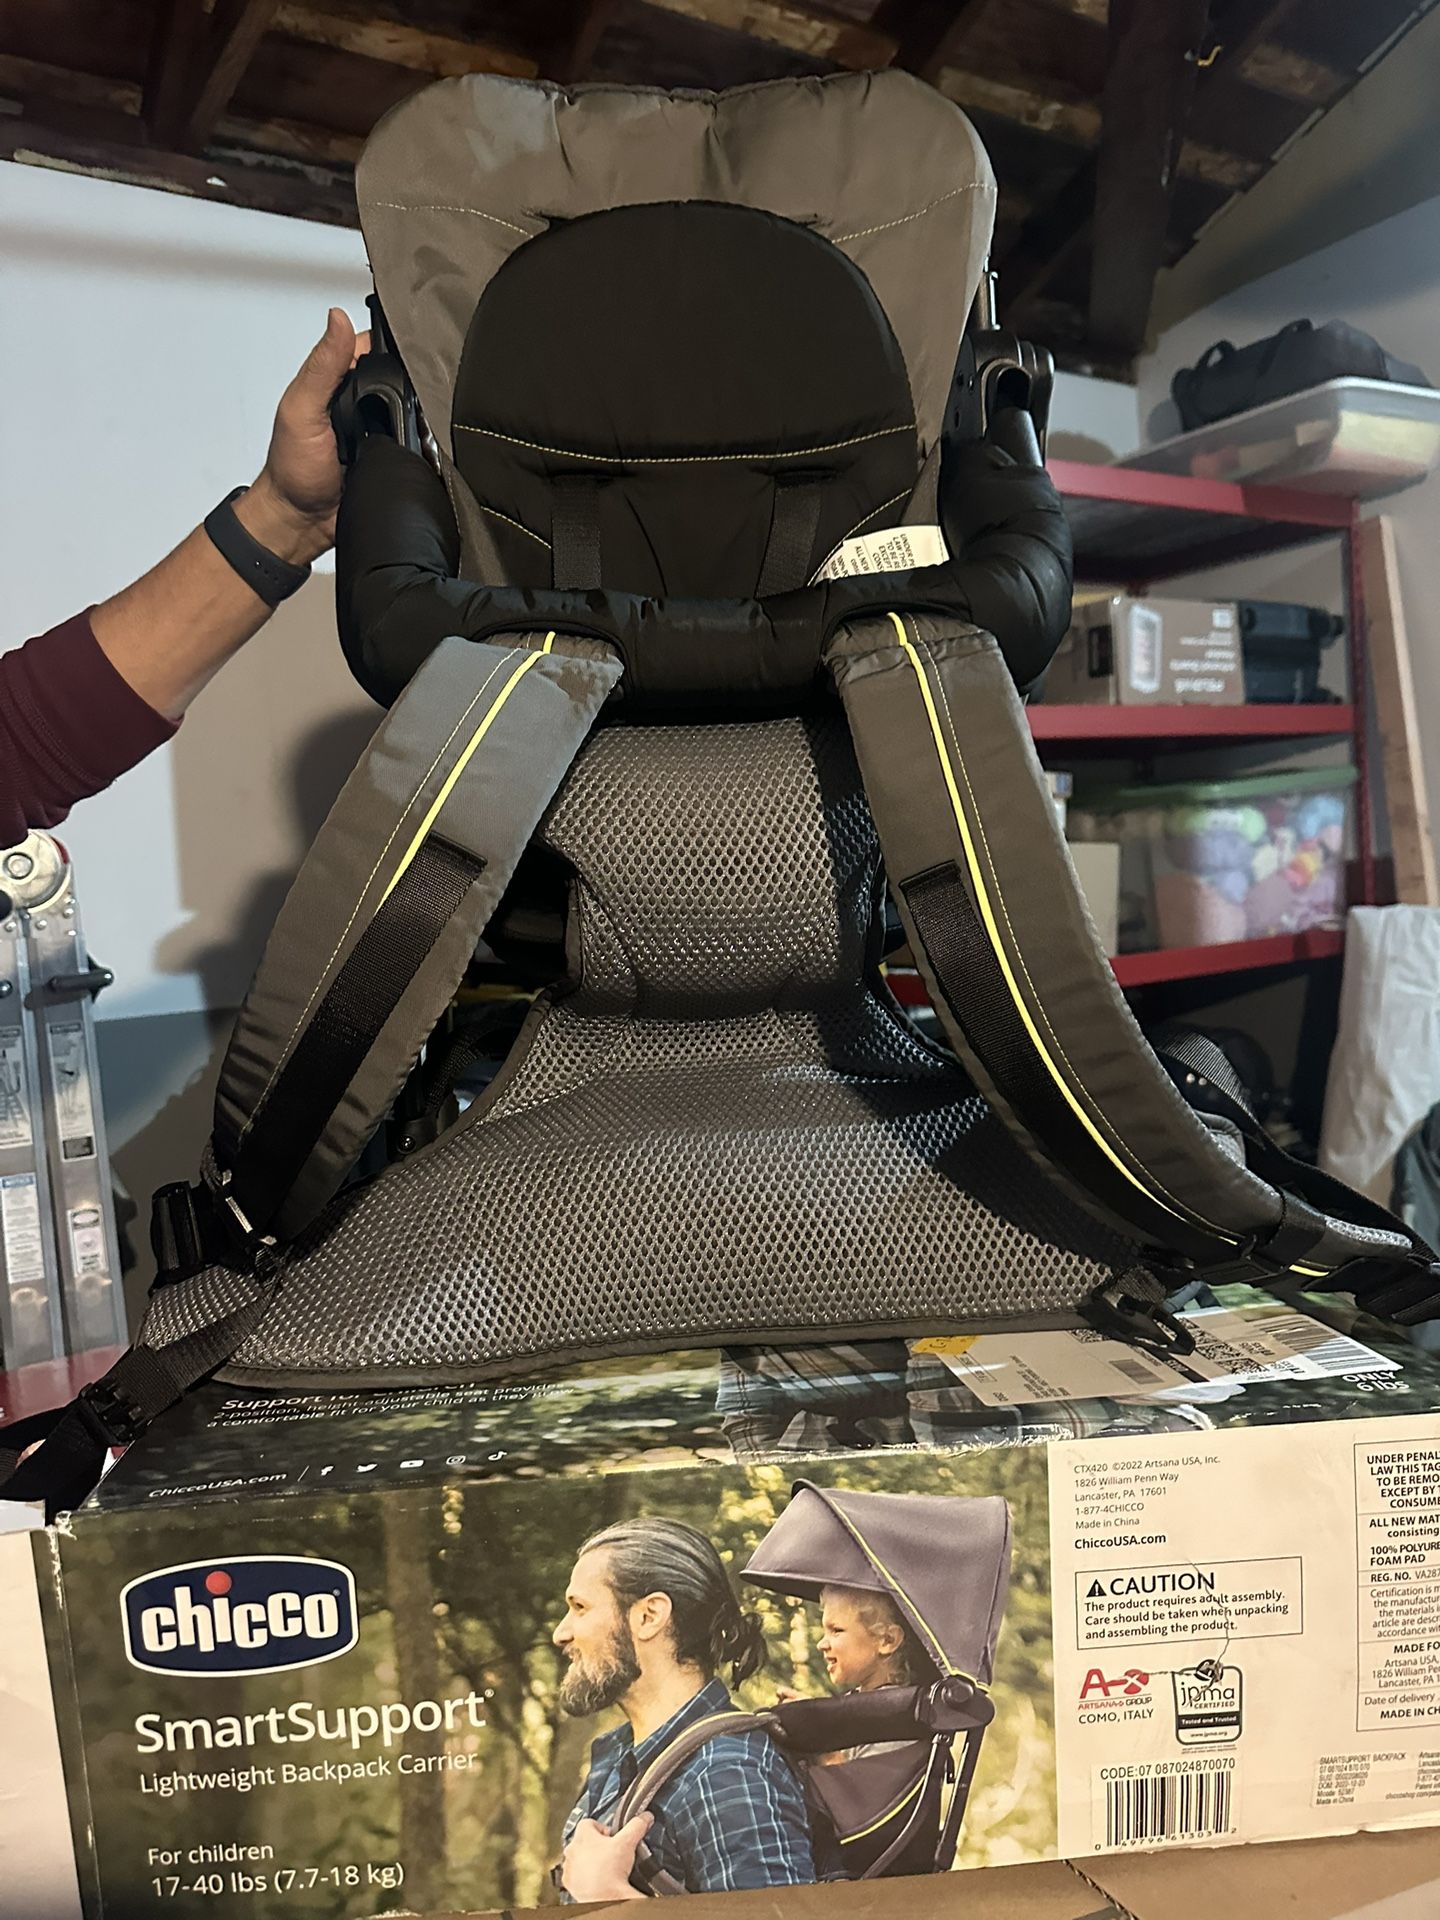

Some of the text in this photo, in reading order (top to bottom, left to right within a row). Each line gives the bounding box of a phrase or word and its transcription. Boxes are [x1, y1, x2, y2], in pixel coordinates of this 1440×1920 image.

[1342, 1371, 1396, 1382] ONLY
[455, 1388, 490, 1397] seat
[221, 1395, 322, 1410] Support
[222, 1411, 325, 1427] comfortable
[330, 1409, 347, 1417] fit
[352, 1406, 377, 1415] for
[379, 1401, 422, 1413] your
[424, 1397, 464, 1406] child
[468, 1396, 487, 1404] as
[492, 1392, 528, 1401] they
[1074, 1463, 1108, 1474] CTX420
[1144, 1458, 1179, 1469] Artsana
[1182, 1456, 1203, 1466] USA,
[1205, 1455, 1221, 1464] Inc.
[1367, 1451, 1440, 1464] UNDER PENAL
[1370, 1465, 1393, 1476] LAW
[1396, 1463, 1420, 1474] THIS
[148, 1473, 287, 1498] ChiccoUSA.com
[1074, 1472, 1179, 1488] 1826 William Penn Way
[1376, 1473, 1440, 1487] TO BE REMO
[1074, 1486, 1167, 1502] Lancaster, PA 17601
[1381, 1486, 1420, 1498] EXCEPT
[1422, 1485, 1435, 1495] BY
[1075, 1502, 1145, 1516] 1-877-4CHICCO
[1075, 1517, 1140, 1530] Made in China
[1369, 1514, 1440, 1528] ALL NEW MAT
[1387, 1526, 1440, 1538] consisting
[1074, 1534, 1167, 1550] ChiccoUSA.com
[1370, 1545, 1398, 1555] 100%
[1370, 1554, 1426, 1566] FOAM PAD
[1110, 1572, 1215, 1596] CAUTION
[1371, 1572, 1393, 1583] REG.
[1394, 1571, 1412, 1581] NO.
[1370, 1586, 1424, 1598] Certification
[1425, 1585, 1432, 1594] is
[1085, 1589, 1285, 1613] The product requires adult assembly.
[1374, 1598, 1388, 1608] the
[141, 1570, 339, 1653] chicco
[1085, 1603, 1289, 1626] Care should be taken when unpacking
[1379, 1608, 1394, 1618] the
[1395, 1605, 1435, 1617] materials
[1085, 1620, 1238, 1640] and assembling the product.
[1372, 1618, 1400, 1628] article
[1401, 1618, 1415, 1627] are
[1377, 1626, 1427, 1638] accordance
[1393, 1641, 1440, 1654] MADE FO
[1384, 1655, 1439, 1668] Artsana USA,
[1372, 1669, 1393, 1679] 1826
[1395, 1667, 1426, 1677] William
[1378, 1677, 1421, 1688] Lancaster,
[1423, 1675, 1434, 1684] PA
[1181, 1681, 1235, 1708] jpma
[1364, 1692, 1436, 1706] Date of delivery
[1078, 1696, 1153, 1710] ARTSANA GROUP
[1194, 1701, 1235, 1709] CERTIFIED
[1078, 1708, 1154, 1725] COMO, ITALY
[1182, 1717, 1200, 1725] Tested
[1215, 1715, 1237, 1723] Trusted
[1380, 1706, 1440, 1720] MADE IN CH
[139, 1750, 479, 1797] Lightweight Backpack Carrier
[1100, 1757, 1236, 1780] CODE:07 087024870070
[148, 1841, 275, 1866] For children
[152, 1861, 405, 1897] 17-40 lbs (7.7-18 kg)
